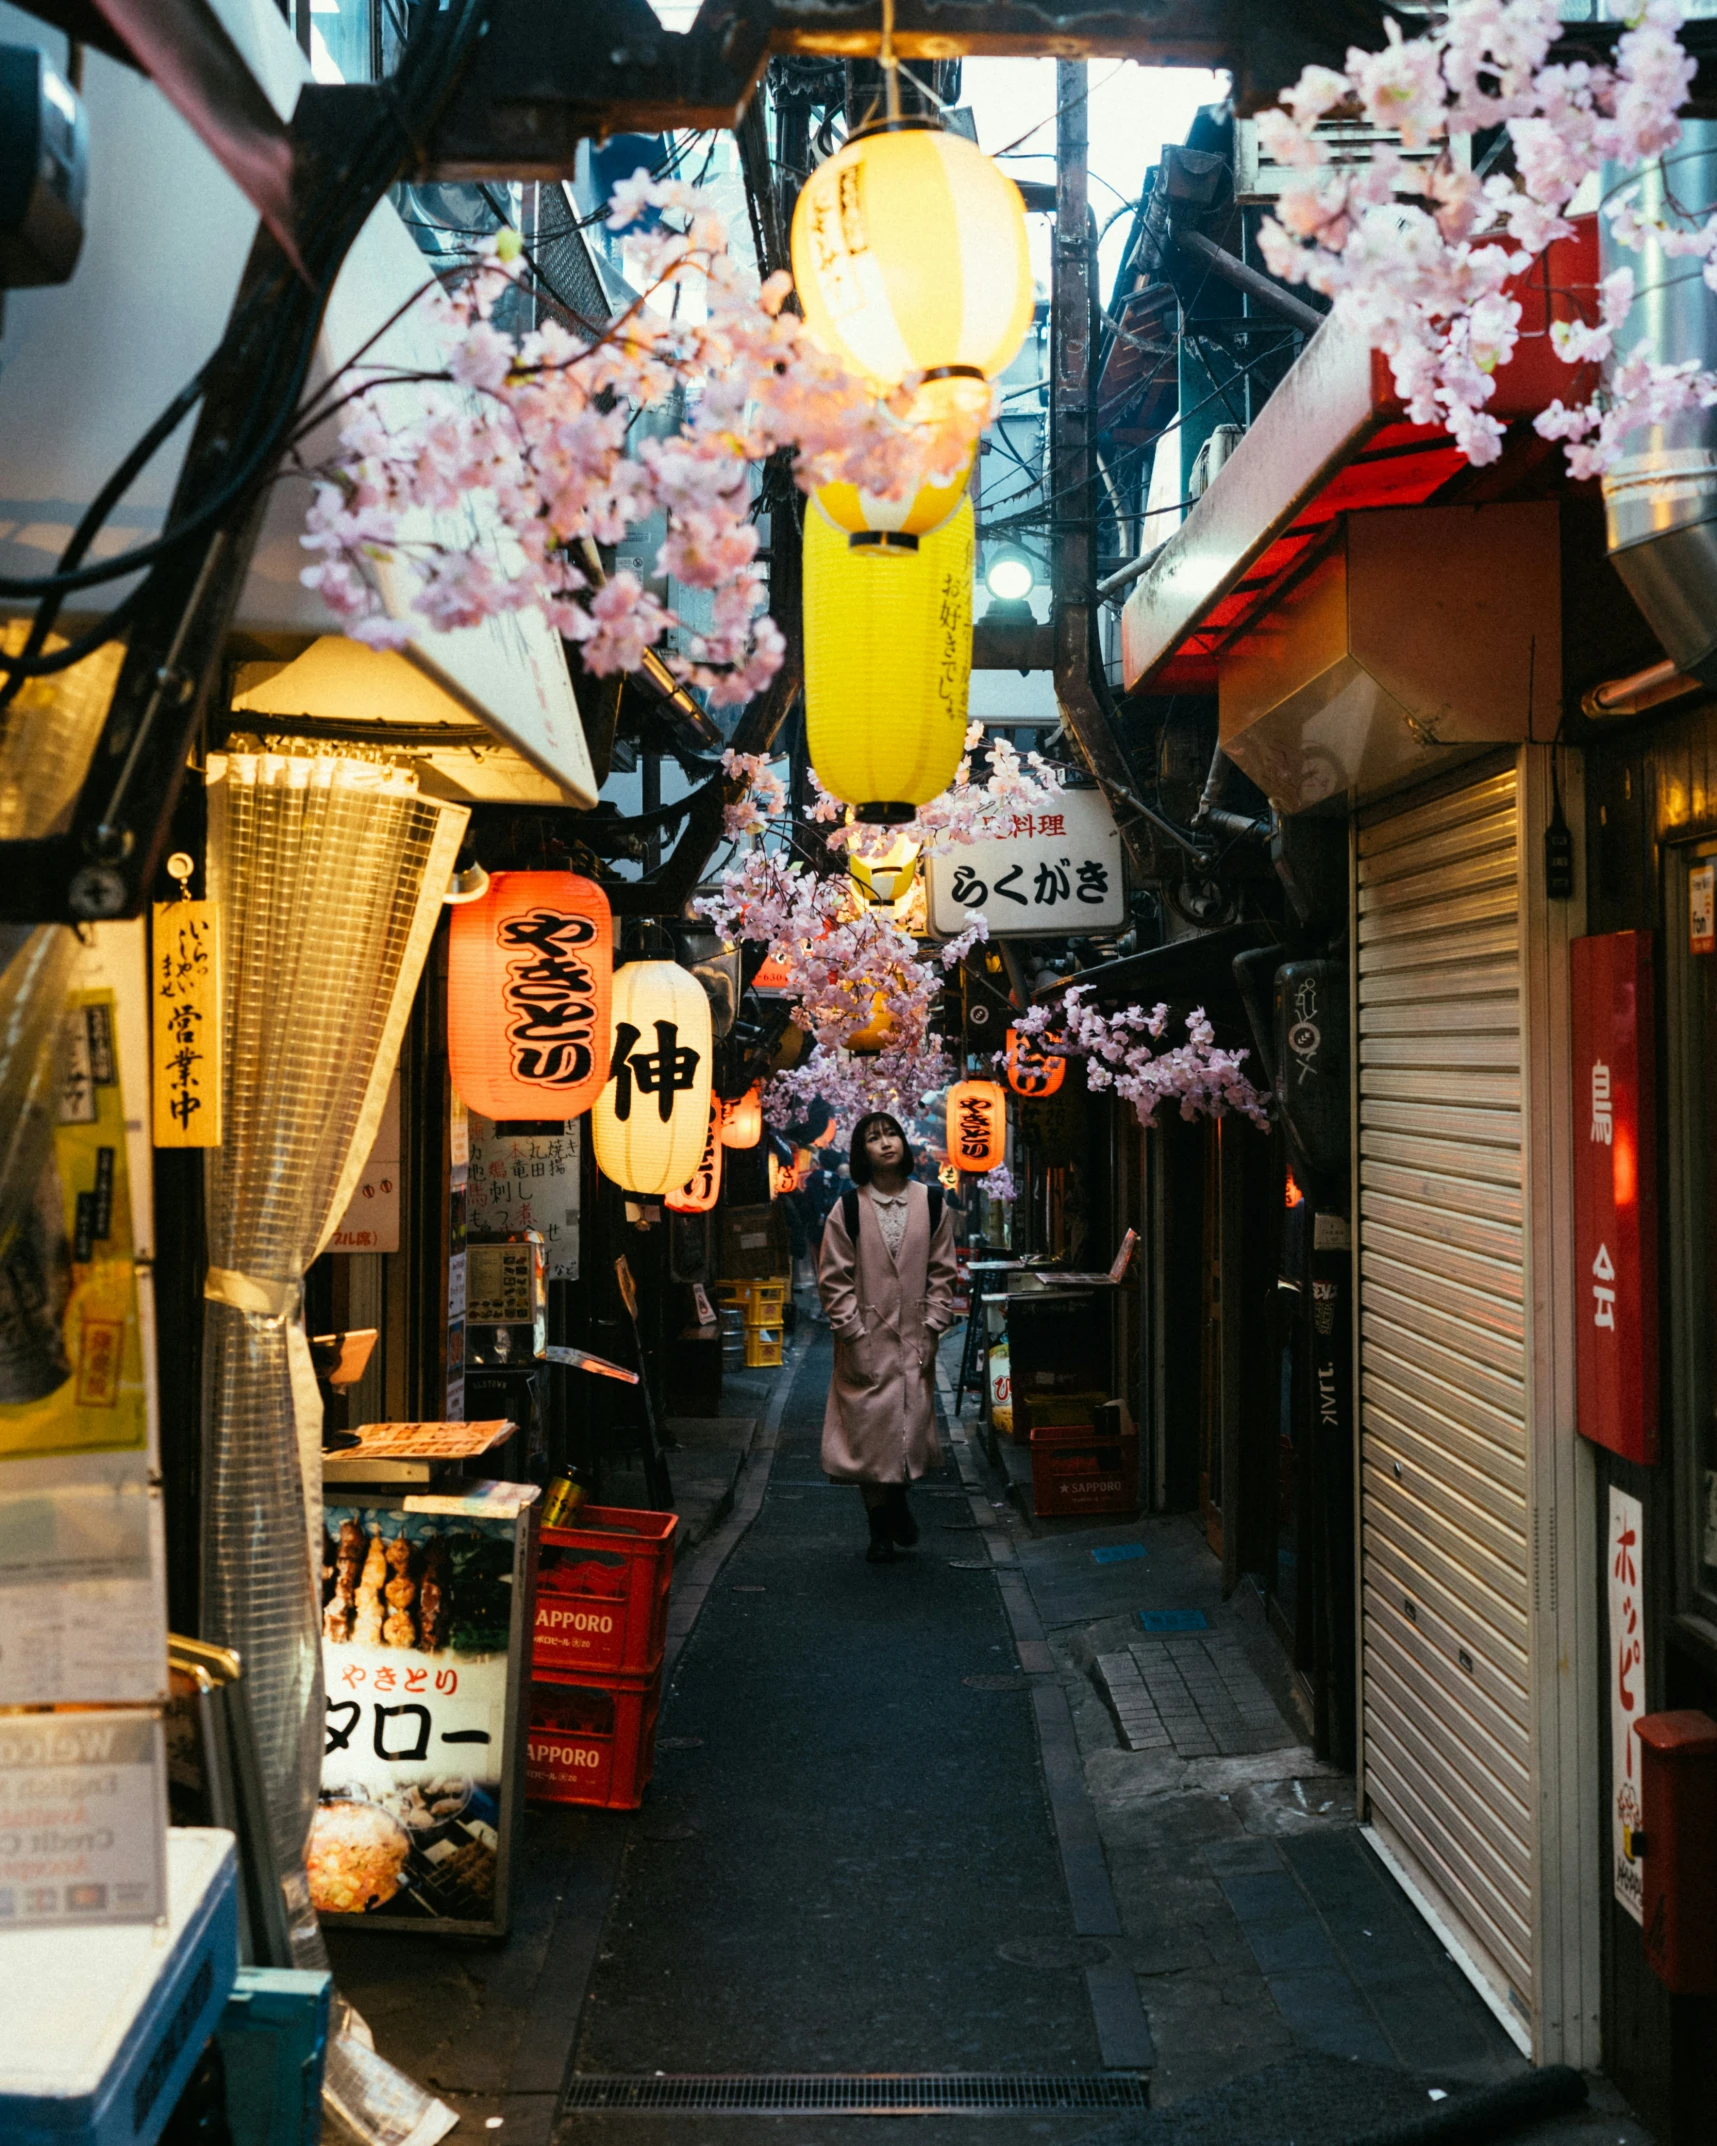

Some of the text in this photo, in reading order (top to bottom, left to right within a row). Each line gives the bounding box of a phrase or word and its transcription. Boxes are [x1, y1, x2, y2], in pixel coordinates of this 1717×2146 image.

[951, 858, 1109, 908] らくがき
[160, 953, 176, 997] ませ
[504, 914, 595, 1083] やきとり
[165, 1004, 204, 1130] 営業中
[607, 1019, 700, 1123] 伸
[960, 1097, 991, 1159] やきとり
[1072, 1480, 1121, 1493] SAPPORO
[535, 1609, 613, 1633] APPORO
[1614, 1508, 1641, 1778] ホッピー
[342, 1664, 458, 1696] やきとり
[325, 1695, 491, 1761] タロー
[527, 1743, 600, 1768] APPORO
